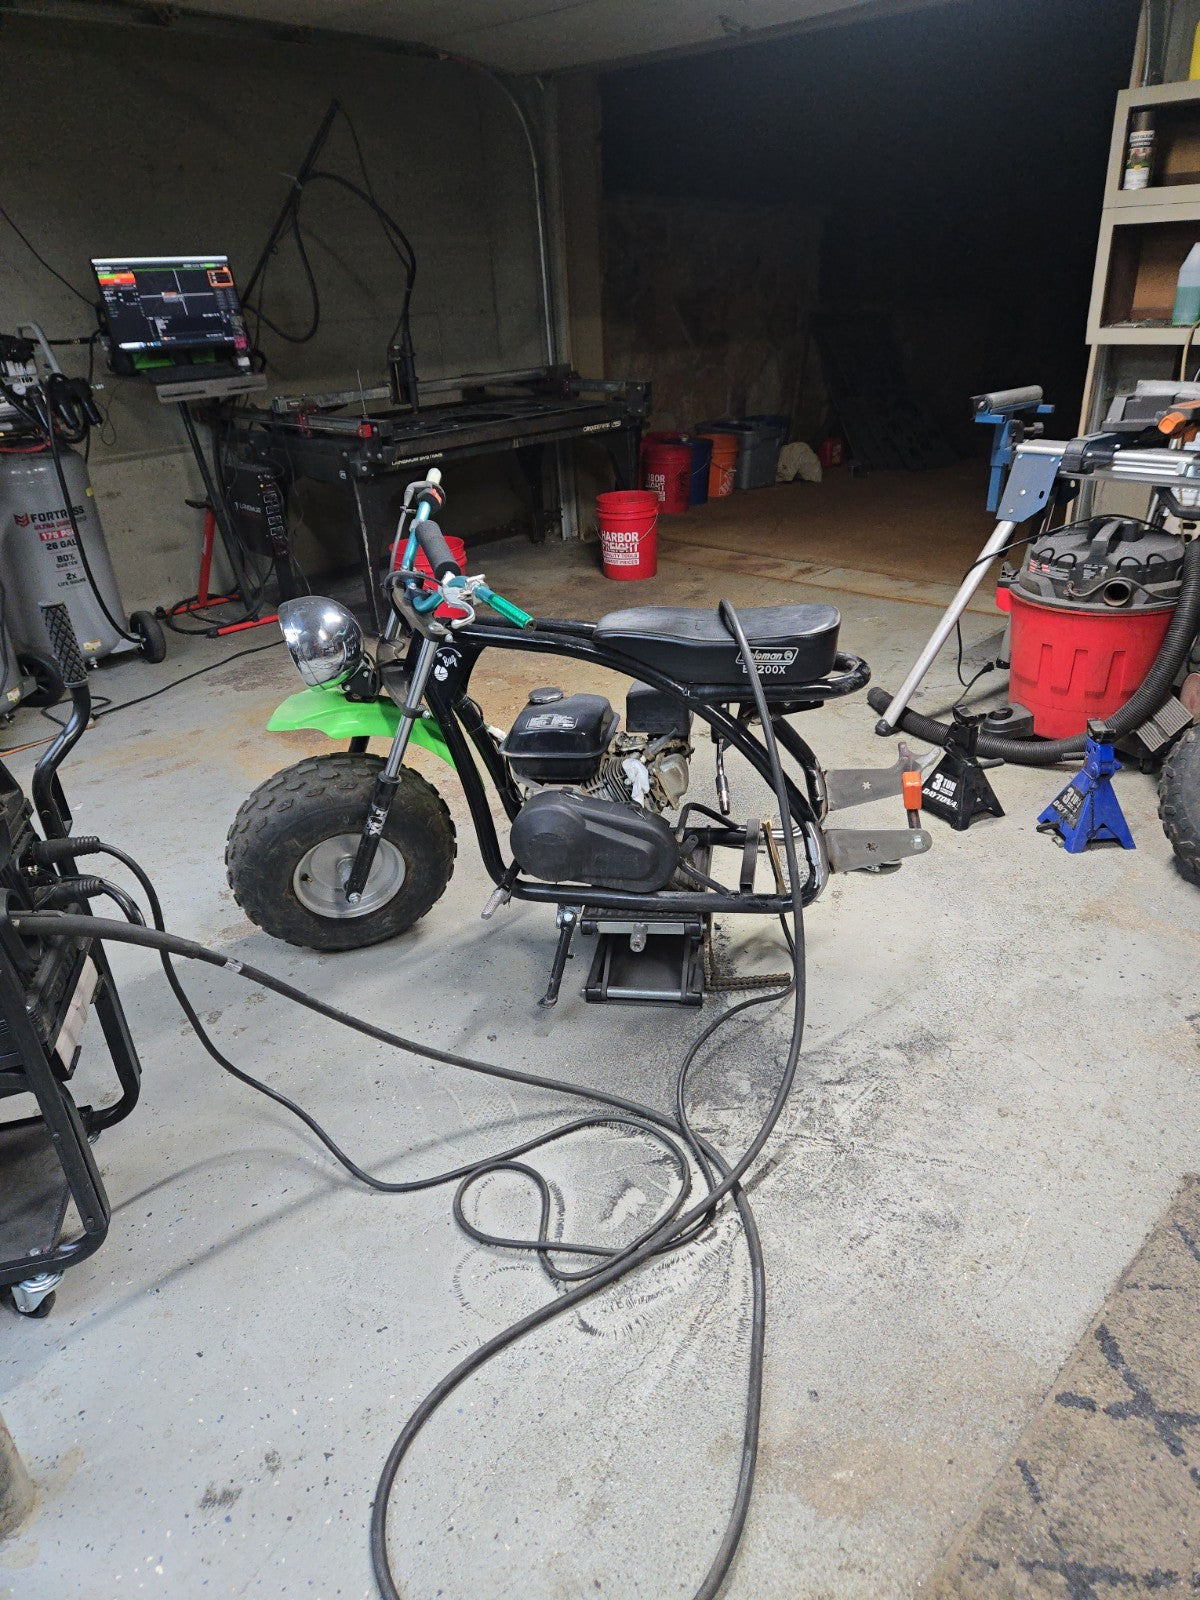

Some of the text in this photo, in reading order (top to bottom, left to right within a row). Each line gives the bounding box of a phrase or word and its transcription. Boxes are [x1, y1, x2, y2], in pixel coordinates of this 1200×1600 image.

[30, 505, 84, 523] FORTRSS
[41, 531, 59, 541] 175
[602, 530, 639, 542] HARBOR
[45, 541, 58, 551] 26
[602, 540, 639, 553] FREIGHT
[931, 773, 944, 791] 3
[942, 778, 957, 792] TON
[922, 787, 958, 811] DAYTONA
[1062, 786, 1075, 805] 3
